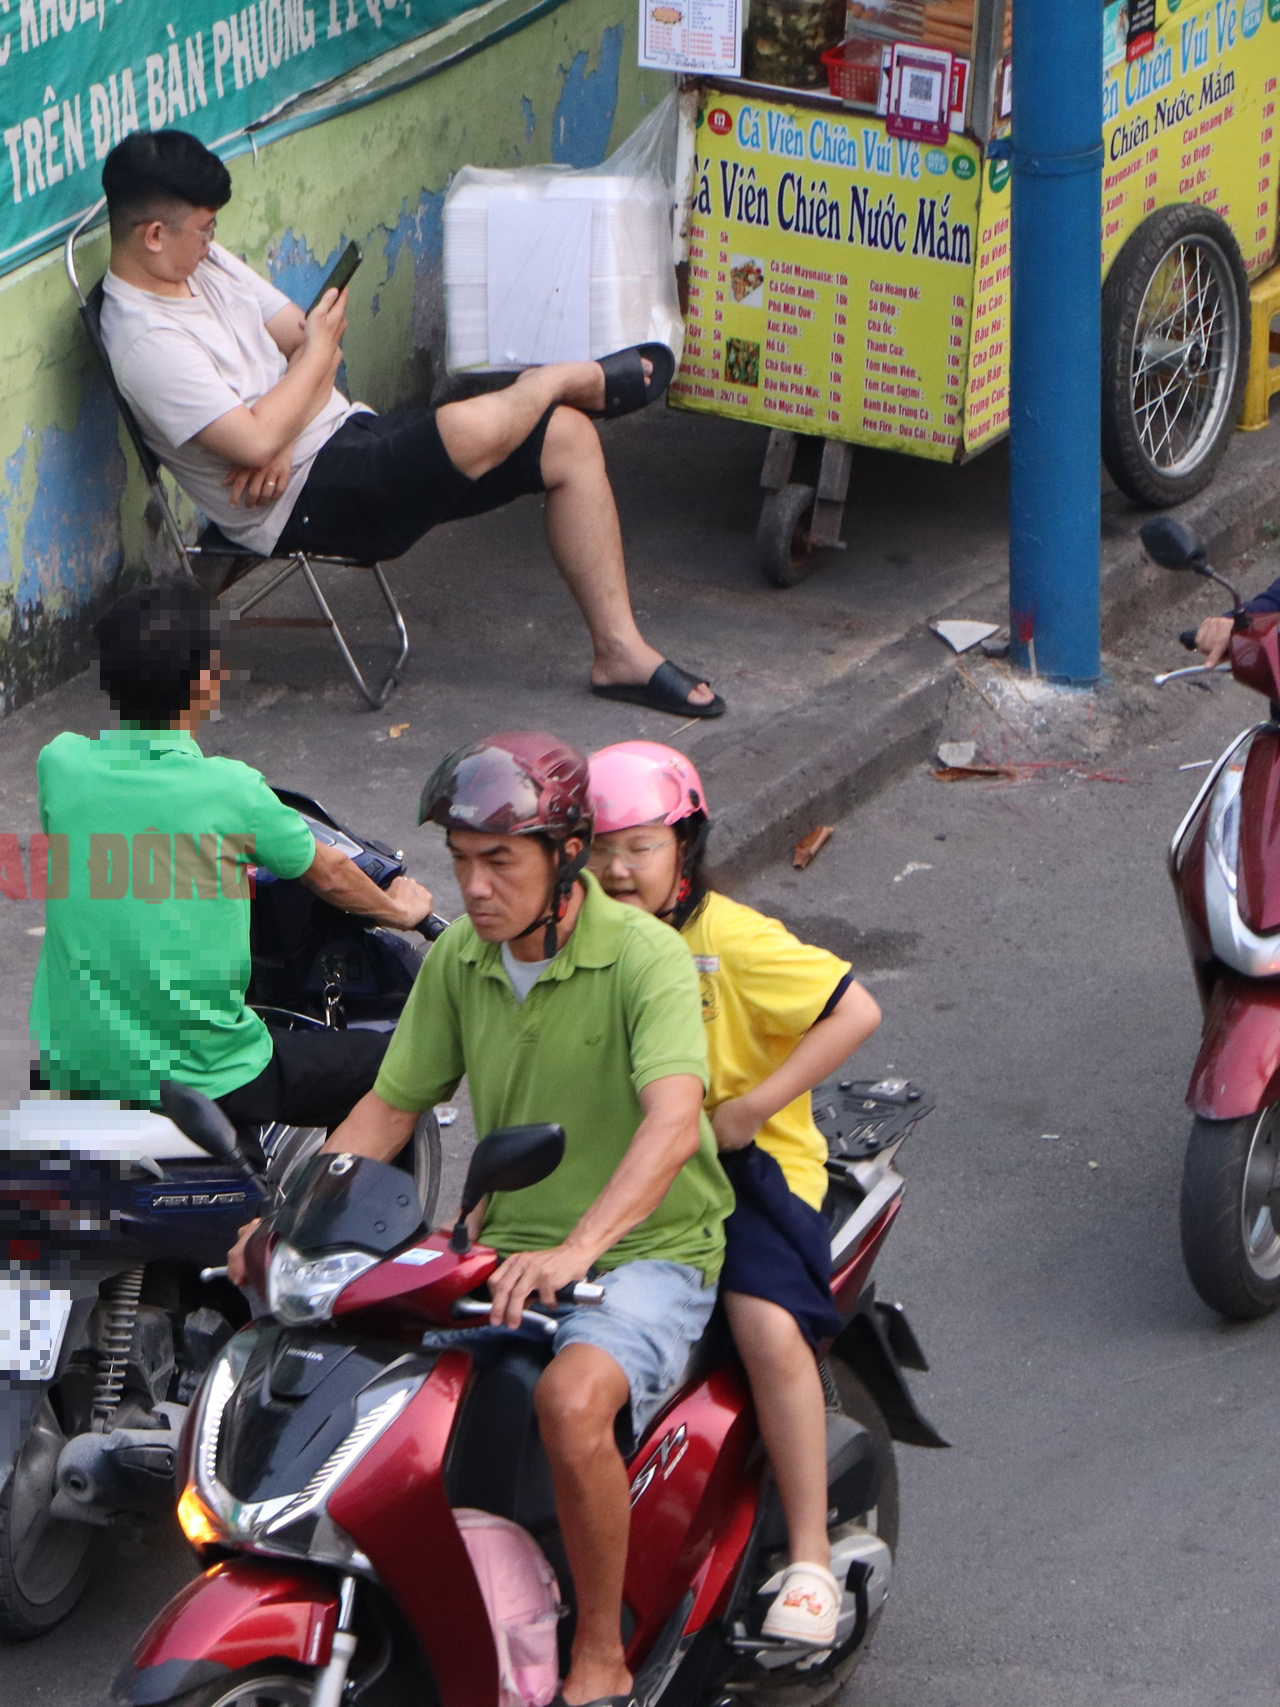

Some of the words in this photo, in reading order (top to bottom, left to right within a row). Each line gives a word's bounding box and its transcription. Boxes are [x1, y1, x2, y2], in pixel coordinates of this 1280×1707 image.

[1181, 11, 1210, 73] Vui
[4, 85, 85, 204] TRÊN
[146, 24, 208, 131] BÀN
[1110, 115, 1149, 161] Chiên
[1154, 89, 1195, 135] Nước
[1199, 62, 1235, 111] Mắm
[738, 106, 761, 150] Cá
[767, 110, 804, 157] Viên
[810, 119, 857, 167] Chiên
[864, 129, 891, 173] Vui
[1146, 147, 1159, 164] 10k
[720, 160, 770, 227] Viên
[777, 172, 841, 241] Chiên
[848, 185, 907, 252] Nước
[912, 194, 971, 264] Mắm
[720, 232, 729, 243] 5k
[720, 251, 728, 263] 5k
[718, 271, 726, 283] 5k
[836, 274, 848, 286] 10k
[836, 293, 848, 306] 10k
[953, 295, 965, 307] 10k
[834, 313, 847, 326] 10k
[951, 315, 964, 327] 10k
[832, 333, 845, 345] 10k
[950, 335, 962, 347] 10k
[831, 352, 843, 365] 10k
[948, 354, 960, 366] 10k
[829, 371, 842, 384] 10k
[947, 374, 959, 387] 10k
[829, 390, 841, 403] 10k
[945, 394, 958, 406] 10k
[828, 410, 840, 423] 10k
[943, 413, 956, 425] 10k
